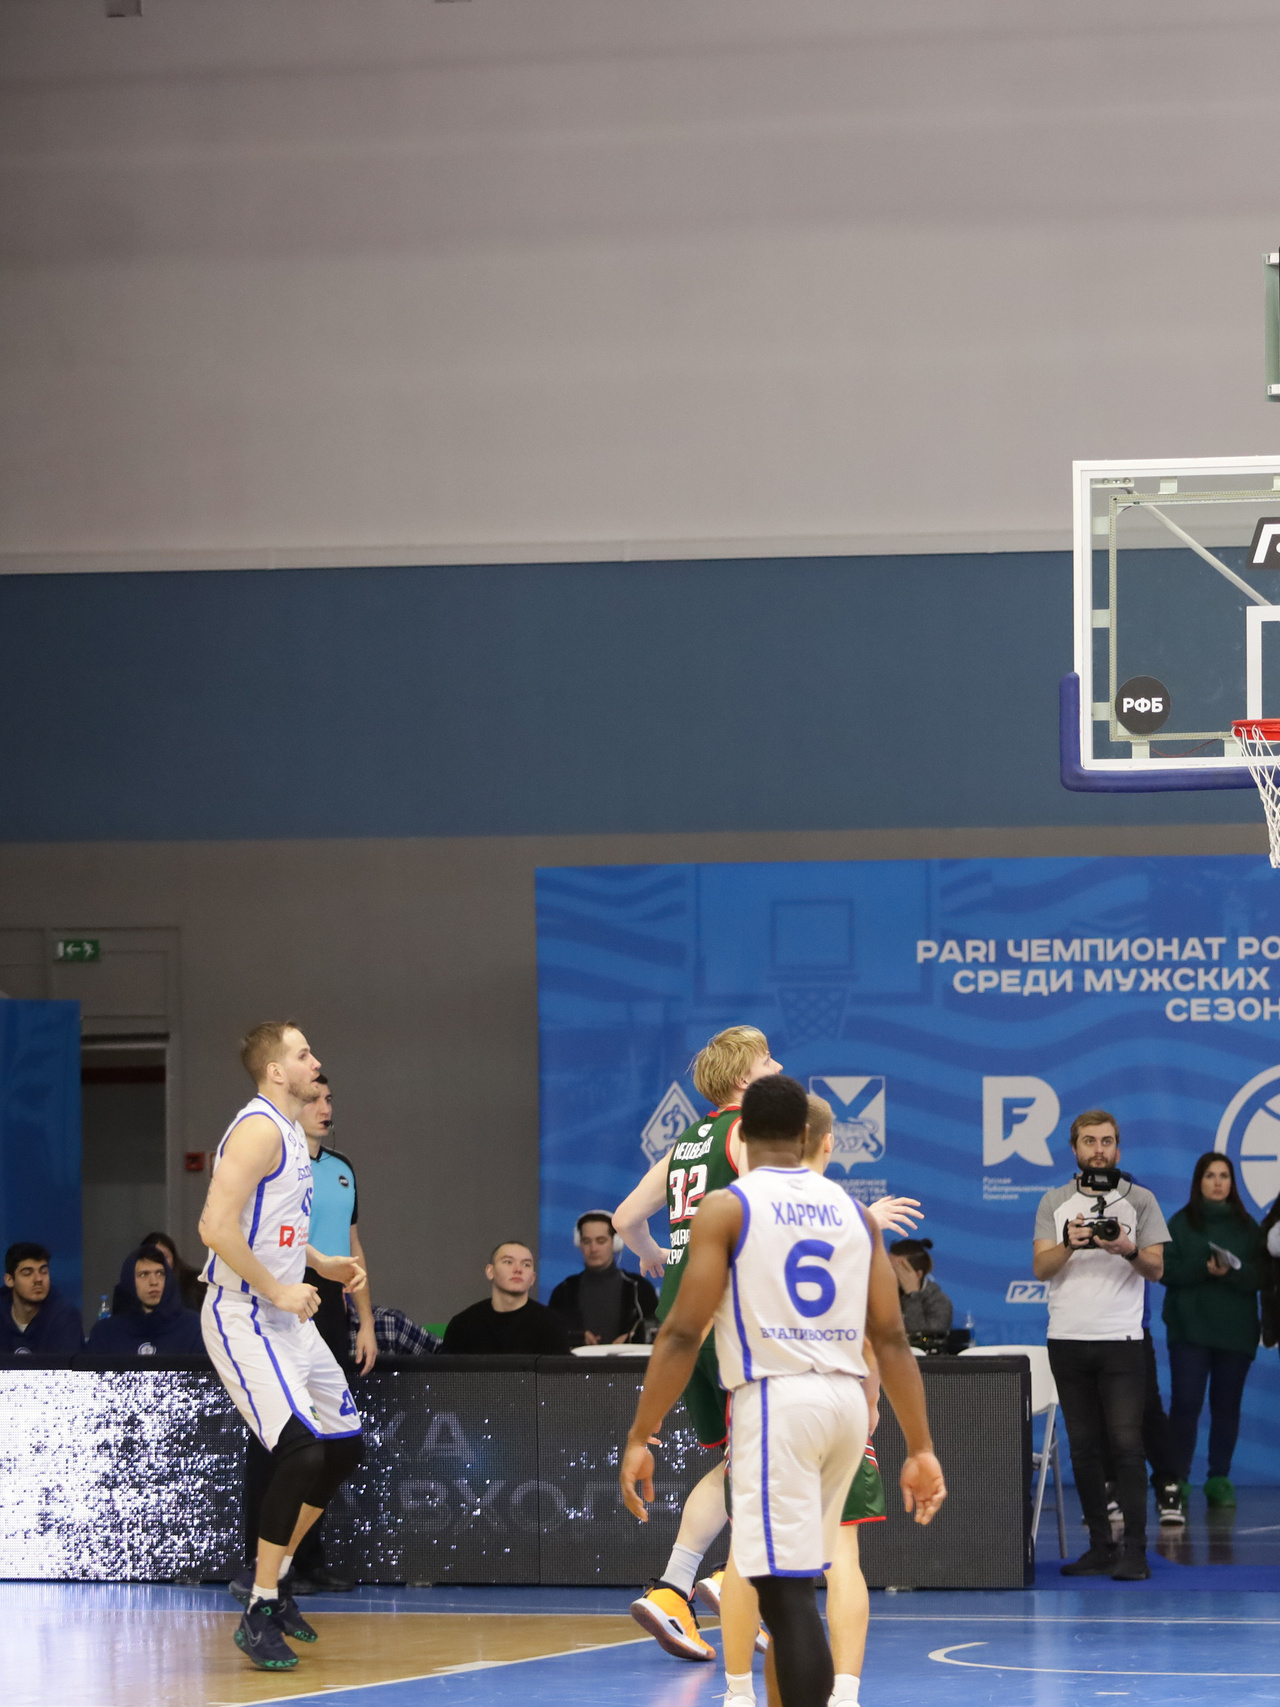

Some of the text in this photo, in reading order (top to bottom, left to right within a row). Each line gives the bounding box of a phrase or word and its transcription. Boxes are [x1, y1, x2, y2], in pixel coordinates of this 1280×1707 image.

[1122, 697, 1164, 714] РФБ
[916, 939, 996, 963] PARI
[1007, 937, 1227, 963] ЧЕМПИОНАТ
[953, 969, 1073, 996] СРЕДИ
[1084, 967, 1270, 992] МУЖСКИХ
[669, 1165, 707, 1221] 32
[771, 1202, 843, 1227] ХАРРИС
[784, 1239, 836, 1318] 6
